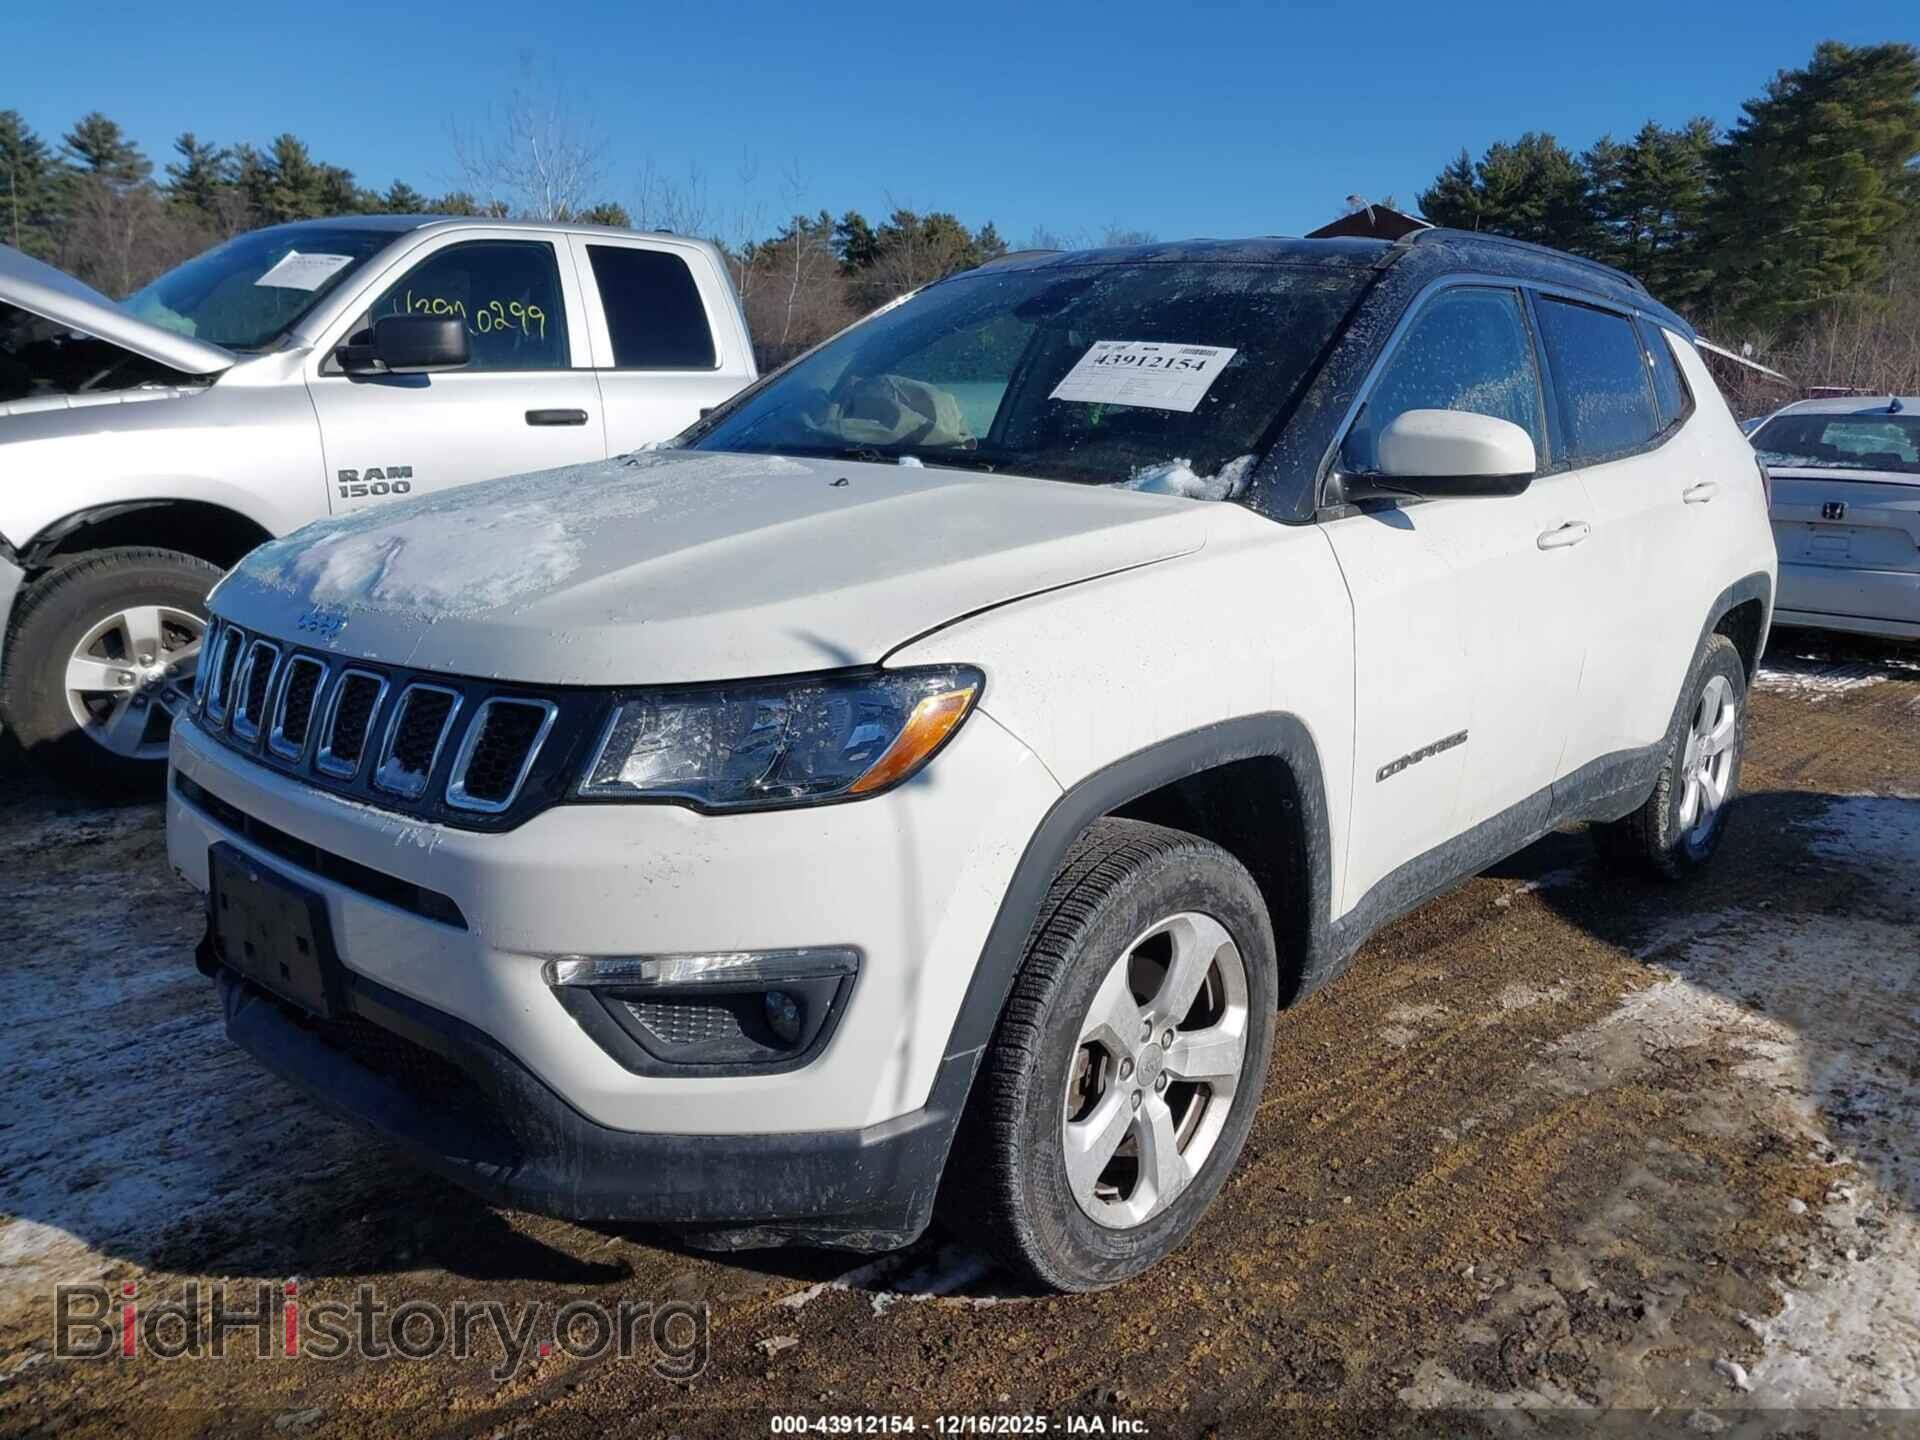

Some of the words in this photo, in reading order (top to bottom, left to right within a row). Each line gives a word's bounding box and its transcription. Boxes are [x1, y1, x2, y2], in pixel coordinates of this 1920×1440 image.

[1094, 353, 1207, 372] 43912154
[338, 466, 413, 482] RAM
[338, 481, 411, 498] 1500
[1375, 728, 1469, 783] COMPASS
